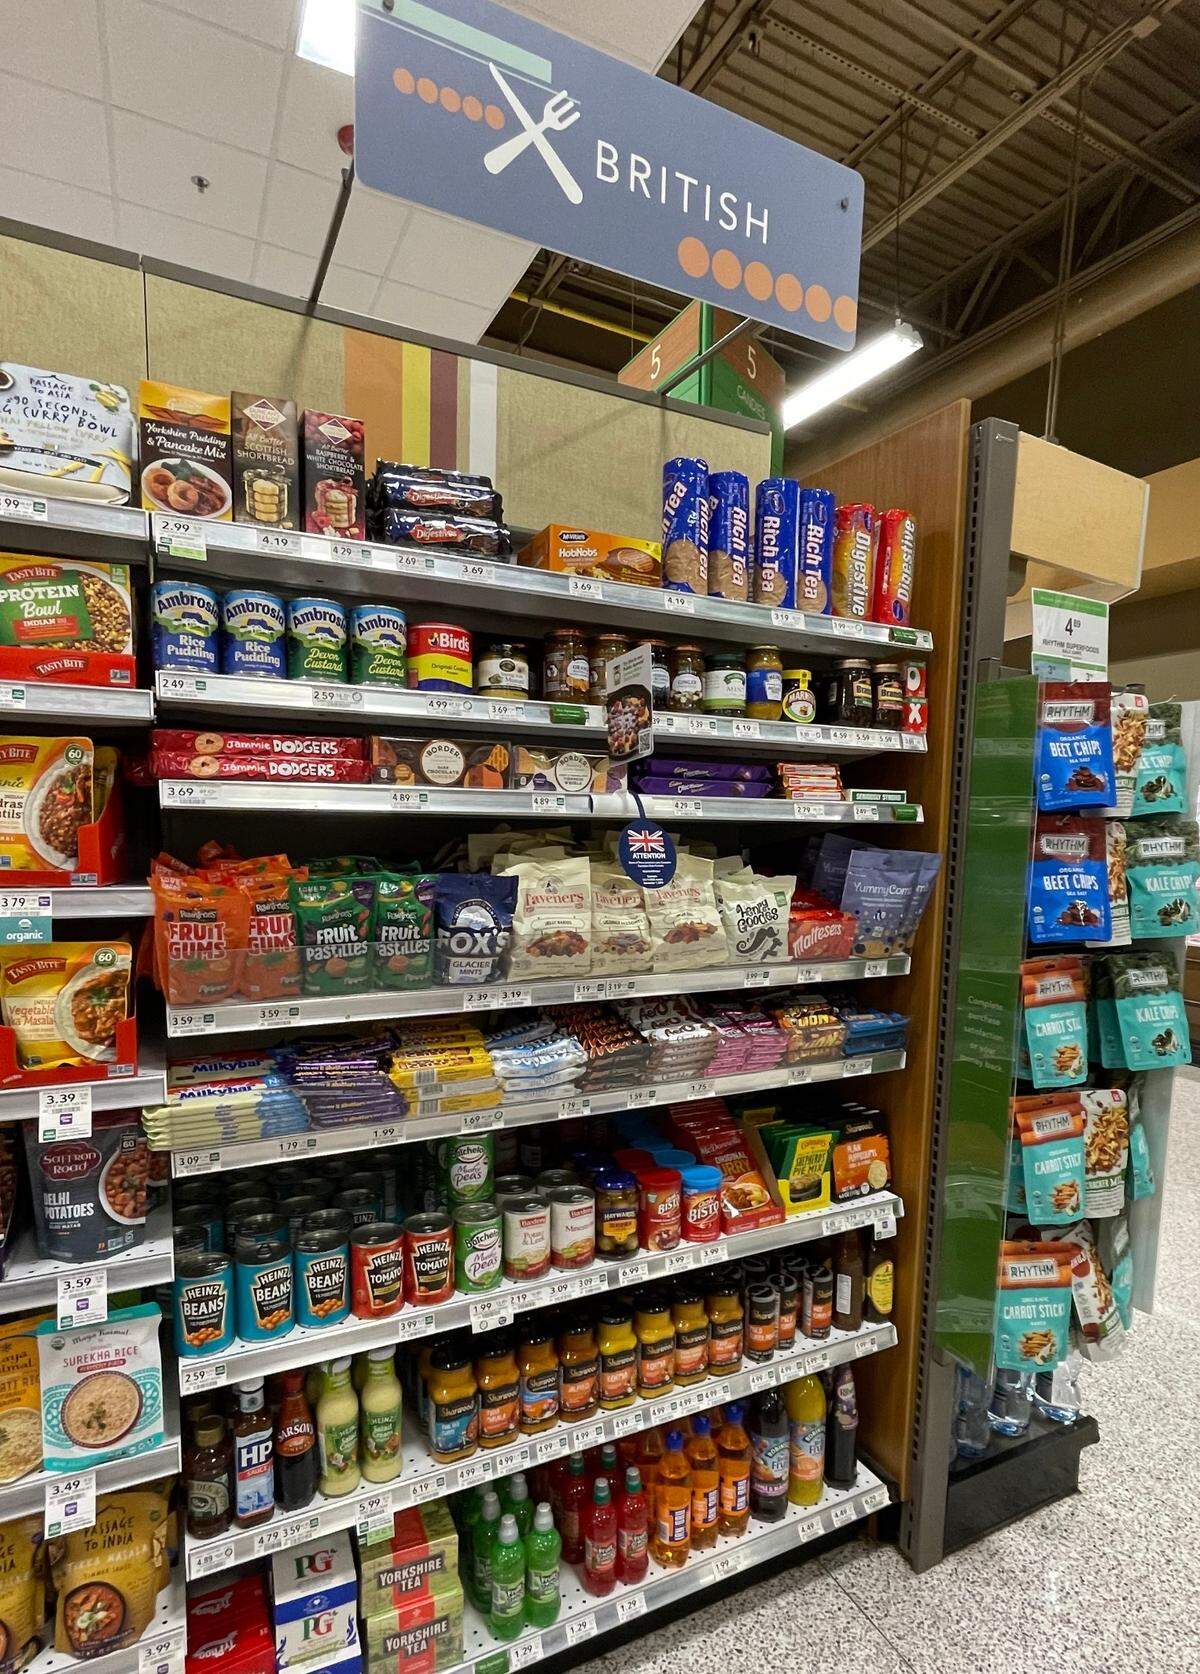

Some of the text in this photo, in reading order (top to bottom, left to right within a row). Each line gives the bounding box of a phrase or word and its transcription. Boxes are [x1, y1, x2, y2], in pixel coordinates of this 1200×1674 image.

[596, 140, 770, 244] BRITISH
[650, 344, 662, 379] 5
[747, 346, 757, 379] 5
[29, 378, 75, 392] PASSAGE
[23, 407, 70, 423] CURRY
[77, 416, 118, 438] BOWL
[145, 422, 227, 448] Yorkshire Pudding
[146, 437, 155, 446] &
[156, 435, 205, 454] Pancake
[205, 444, 227, 459] Mix
[244, 442, 288, 455] SCOTTISH
[315, 448, 349, 461] RASPBERRY
[237, 449, 295, 466] SHORTBREAD
[306, 454, 364, 472] WHITE CHOCOLATE
[316, 461, 355, 476] SHORTBREAD
[161, 520, 190, 532] 2.99
[262, 536, 289, 547] 4.19
[731, 506, 747, 586] Rich Tea
[558, 547, 598, 558] HobNobs
[762, 516, 781, 593] Rich Tea
[897, 517, 916, 601] Digestive
[803, 524, 824, 600] Rich Tea
[7, 566, 58, 582] TASTY BITE
[852, 530, 871, 617] Digestive
[0, 584, 80, 603] PROTEIN
[20, 600, 62, 618] Bowl
[225, 598, 284, 627] Ambrosia
[23, 618, 56, 627] INDIAN
[179, 635, 206, 647] Rice
[245, 641, 271, 653] Rice
[436, 633, 470, 651] Bird's
[1042, 639, 1065, 649] RHYTHM
[1066, 642, 1100, 654] SUPERFOODS
[166, 645, 215, 663] Pudding
[234, 650, 281, 668] Pudding
[309, 647, 340, 661] Devon
[373, 654, 402, 667] Devon
[36, 658, 86, 675] TASTY BITE
[303, 656, 343, 671] Custard
[1046, 704, 1092, 718] RHYTHM
[8, 748, 31, 759] BITE
[68, 750, 82, 758] 60
[226, 739, 339, 755] Jammie DODGERS
[426, 745, 460, 757] BORDER
[1050, 741, 1102, 757] BEET CHIPS
[559, 754, 588, 767] BORDER
[222, 761, 336, 778] Jammie DODGERS
[1044, 837, 1086, 851] RHYTHM
[1142, 840, 1184, 853] RHYTHM
[632, 852, 666, 860] ATTENTION
[1043, 876, 1099, 891] BEET CHIPS
[525, 890, 584, 908] Taveners
[736, 899, 770, 918] Henry
[168, 922, 225, 942] FRUIT
[250, 915, 296, 936] FRUIT
[6, 930, 44, 943] organic
[249, 933, 296, 955] GUMS
[437, 928, 511, 955] FOX'S
[792, 923, 843, 958] Maltesers
[98, 953, 112, 962] 60
[168, 940, 228, 961] GUMS
[7, 960, 60, 979] TASTY BITE
[451, 960, 491, 969] GLACIER
[459, 967, 483, 976] MINTS
[1132, 971, 1167, 984] RHYTHM
[502, 990, 522, 999] 3.19
[1039, 981, 1073, 995] RHYTHM
[467, 992, 488, 1002] 2.39
[8, 1005, 55, 1016] Vegetable
[1136, 1005, 1180, 1023] KALE CHIPS
[1035, 1022, 1067, 1037] CARROT
[193, 1059, 262, 1074] Milkybar
[46, 1093, 76, 1105] 3.39
[179, 1084, 253, 1100] Milkybar
[1034, 1115, 1071, 1132] RHYTHM
[373, 1128, 395, 1138] 1.99
[122, 1140, 134, 1148] 60
[43, 1151, 97, 1166] Saffron
[714, 1153, 747, 1165] ORIGINAL
[1034, 1157, 1061, 1176] CARROT
[53, 1162, 87, 1174] Road
[793, 1163, 823, 1176] PIE MIX
[454, 1171, 483, 1187] Peas
[43, 1191, 70, 1206] DELHI
[44, 1202, 95, 1220] POTATOES
[688, 1200, 721, 1224] BISTO
[418, 1241, 450, 1255] HEINZ
[313, 1257, 343, 1274] HEINZ
[373, 1250, 402, 1268] HEINZ
[415, 1258, 449, 1272] TOMATO
[471, 1257, 499, 1276] Peas
[260, 1267, 291, 1286] HEINZ
[370, 1266, 402, 1284] TOMATO
[1009, 1263, 1054, 1278] RHYTHM
[63, 1277, 92, 1291] 3.59
[309, 1270, 345, 1290] BEANS
[187, 1286, 220, 1299] HEINZ
[256, 1279, 292, 1302] BEANS
[183, 1297, 224, 1317] BEANS
[63, 1351, 111, 1368] SUREKHA
[115, 1345, 139, 1356] RICE
[372, 1415, 395, 1425] HEINZ
[240, 1439, 273, 1468] HP
[247, 1464, 271, 1476] SAUCE
[52, 1479, 81, 1496] 3.49
[84, 1515, 135, 1537] PASSAGE
[101, 1534, 134, 1549] INDIA
[293, 1550, 334, 1580] PG
[379, 1556, 443, 1588] YORKSHIRE
[400, 1578, 422, 1593] TEA
[620, 1599, 637, 1612] 1.29
[303, 1611, 334, 1637] PG
[570, 1621, 587, 1634] 1.29
[385, 1619, 448, 1652] YORKSHIRE
[145, 1641, 171, 1657] 3.99
[406, 1640, 428, 1656] TEA
[514, 1645, 533, 1658] 1.29
